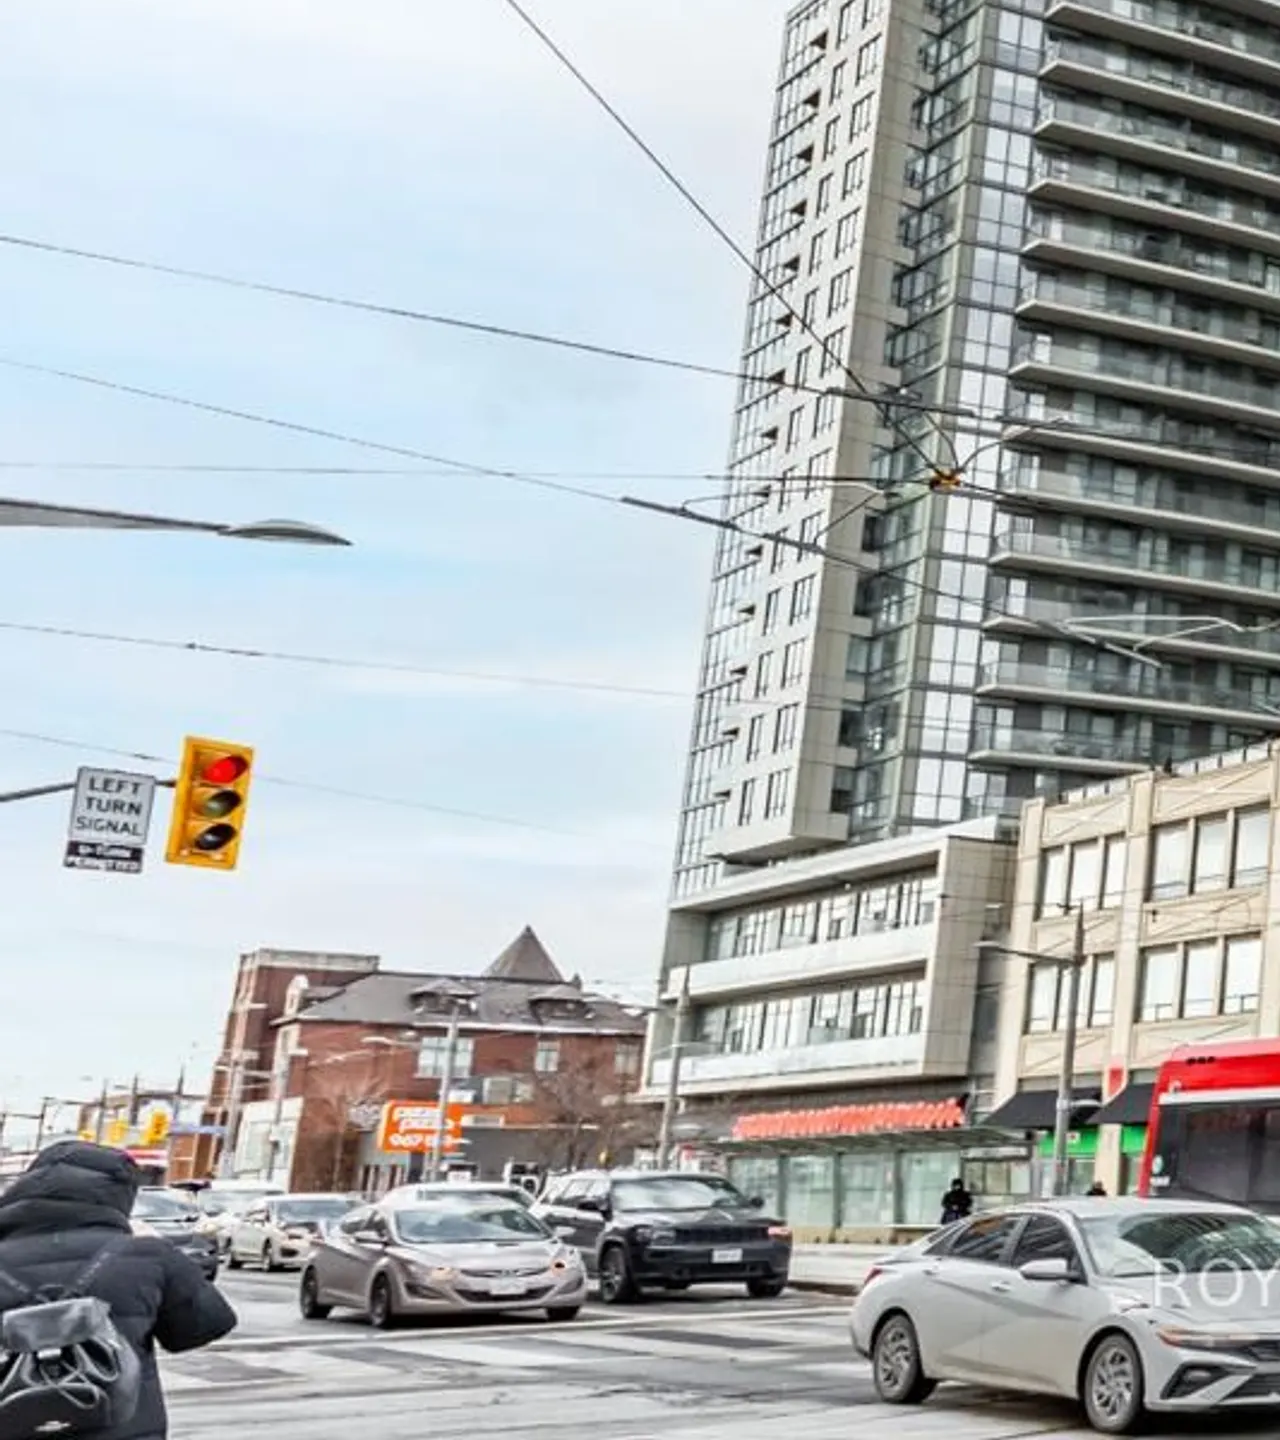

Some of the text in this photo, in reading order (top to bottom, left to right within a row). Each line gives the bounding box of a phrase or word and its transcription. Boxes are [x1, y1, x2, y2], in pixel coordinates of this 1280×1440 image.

[89, 776, 142, 795] LEFT
[86, 797, 144, 815] TURN
[76, 816, 143, 837] SIGNAL
